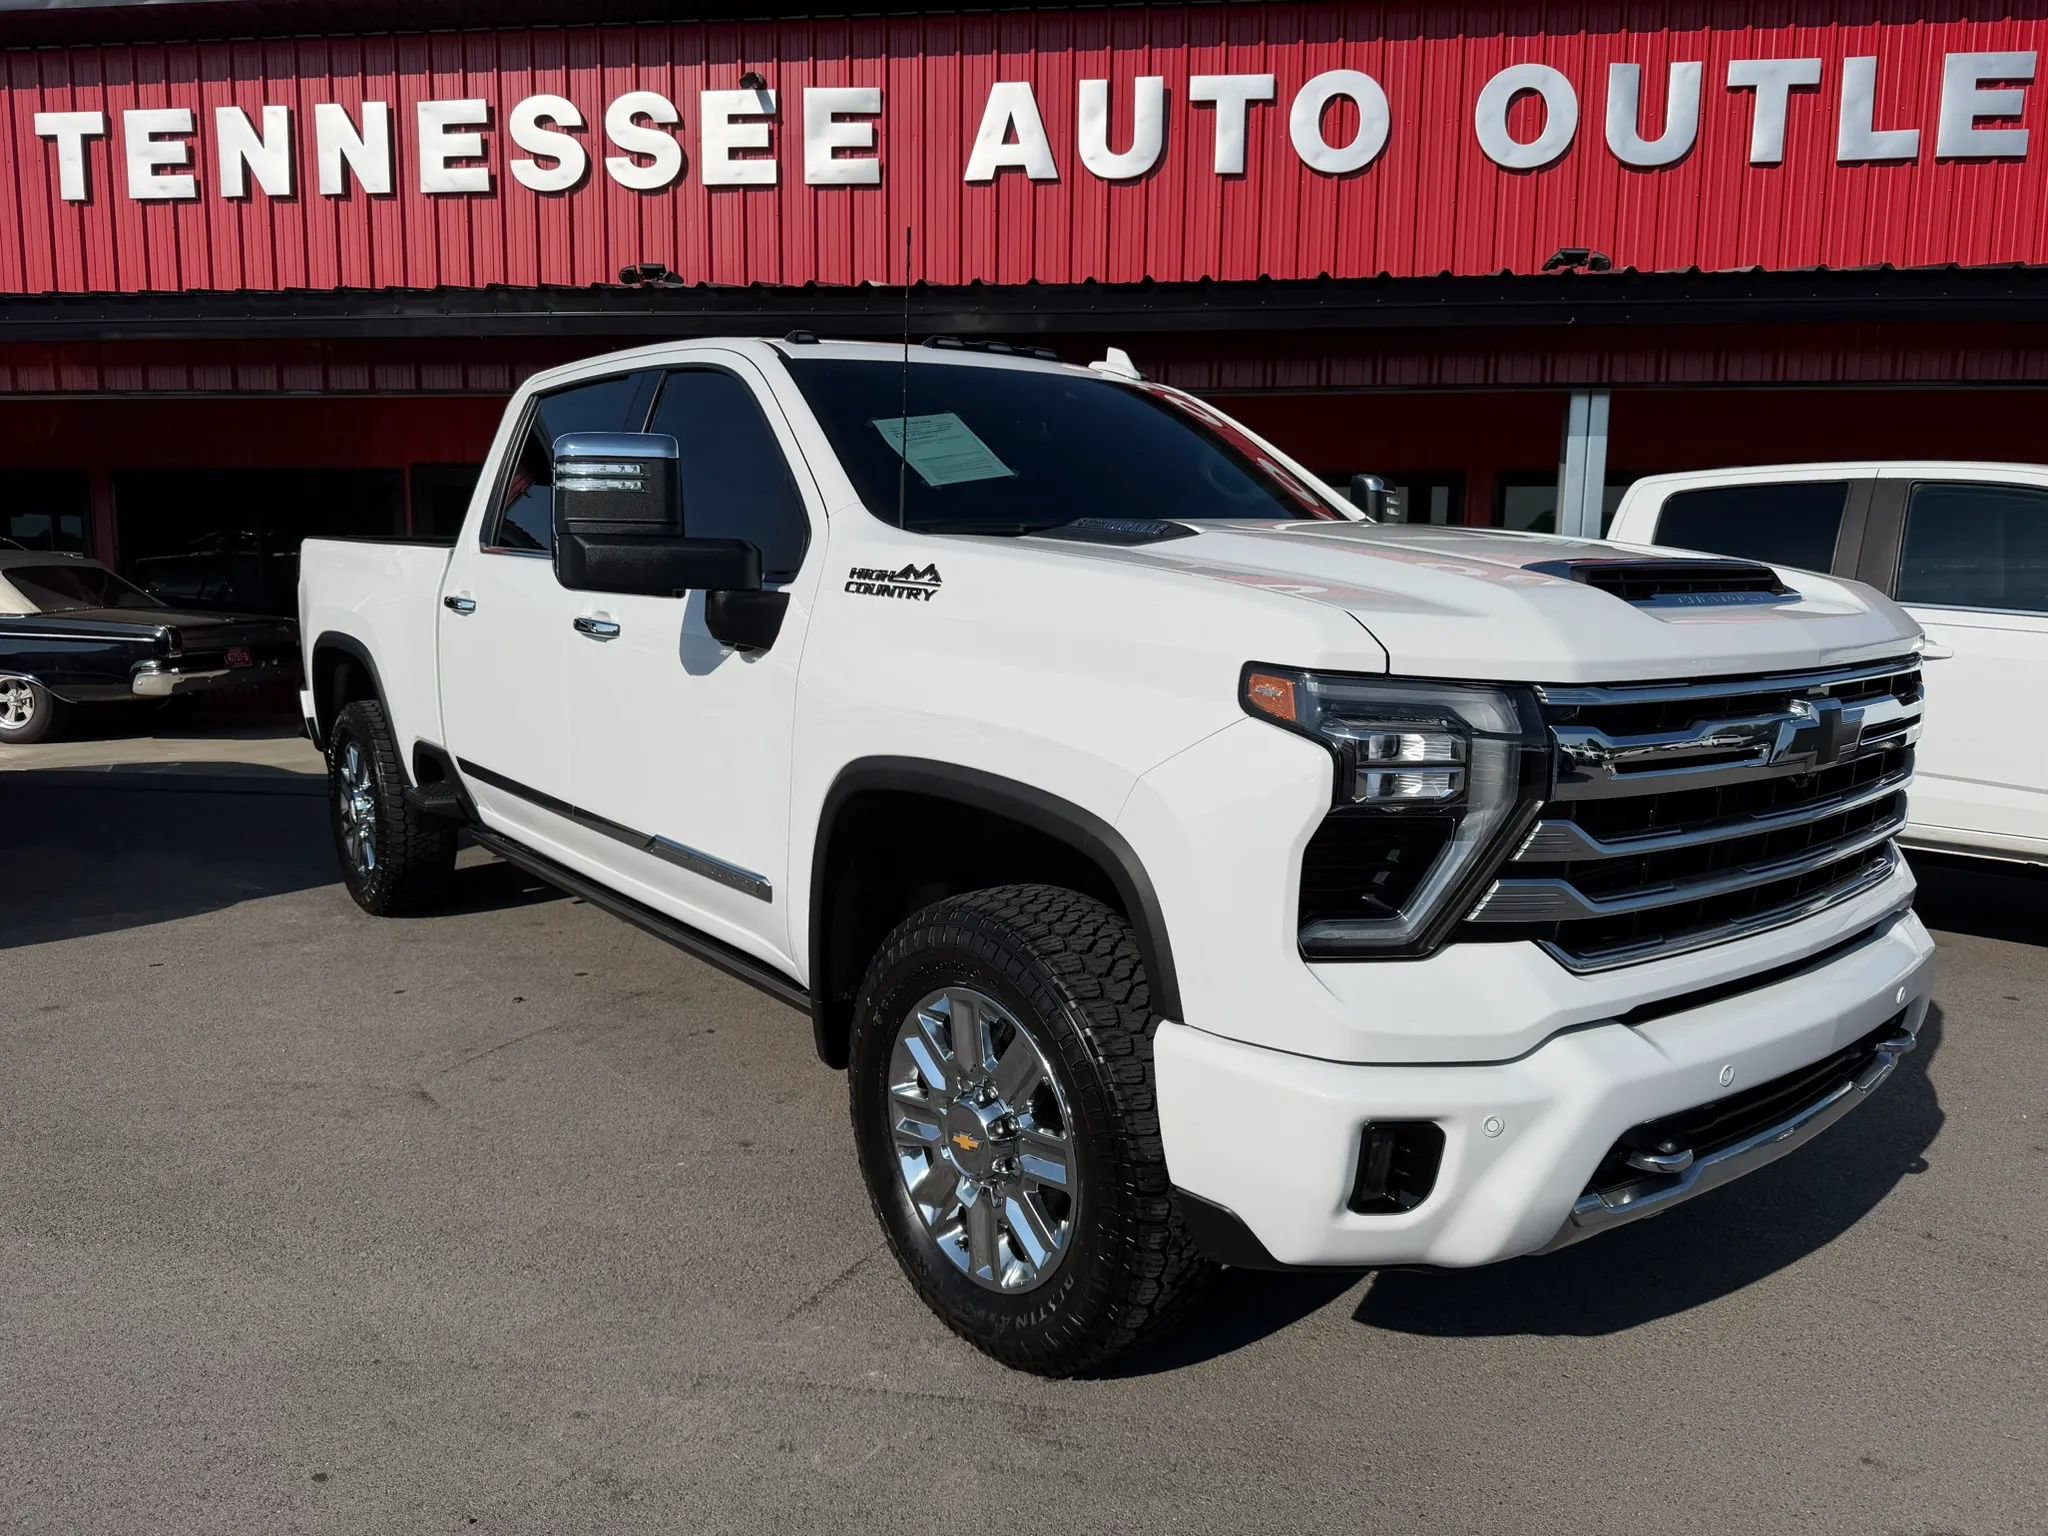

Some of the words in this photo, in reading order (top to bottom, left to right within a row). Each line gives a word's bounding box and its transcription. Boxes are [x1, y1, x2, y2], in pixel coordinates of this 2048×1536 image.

[34, 86, 882, 201] TENNESSEE
[964, 69, 1390, 182] AUTO
[1475, 50, 2038, 169] OUTLE
[848, 567, 897, 582] HIGH
[844, 581, 939, 602] COUNTRY
